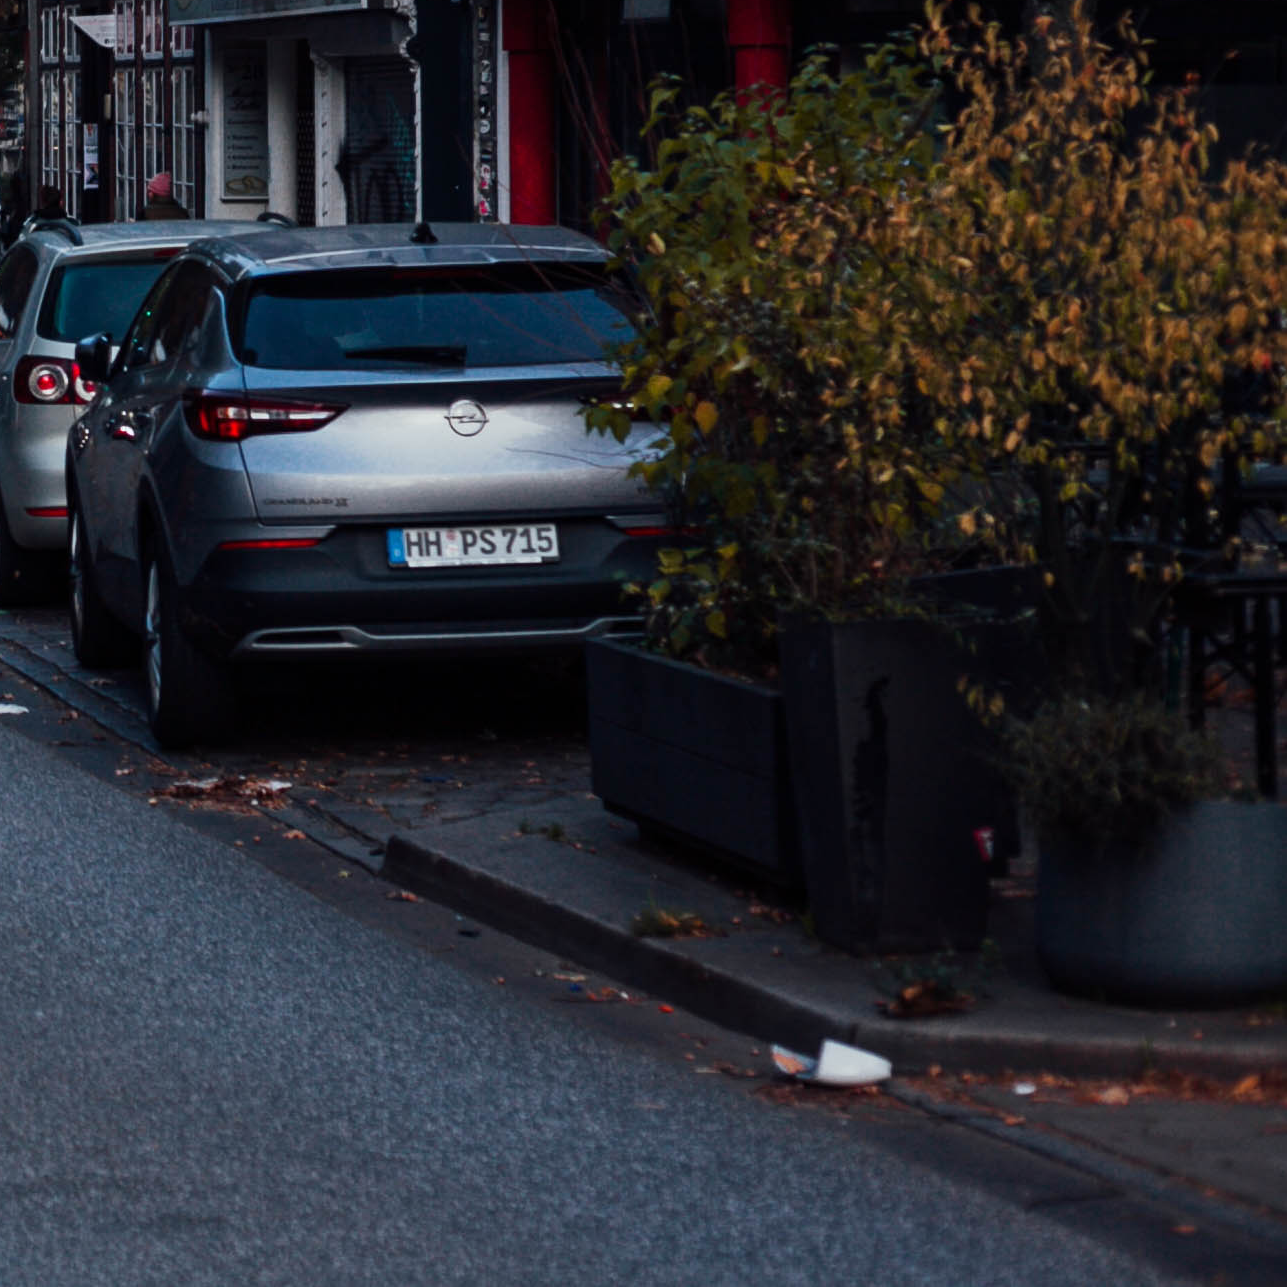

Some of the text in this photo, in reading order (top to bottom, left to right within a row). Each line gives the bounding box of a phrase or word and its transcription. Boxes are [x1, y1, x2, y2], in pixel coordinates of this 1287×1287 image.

[405, 526, 554, 557] HH PS 715
